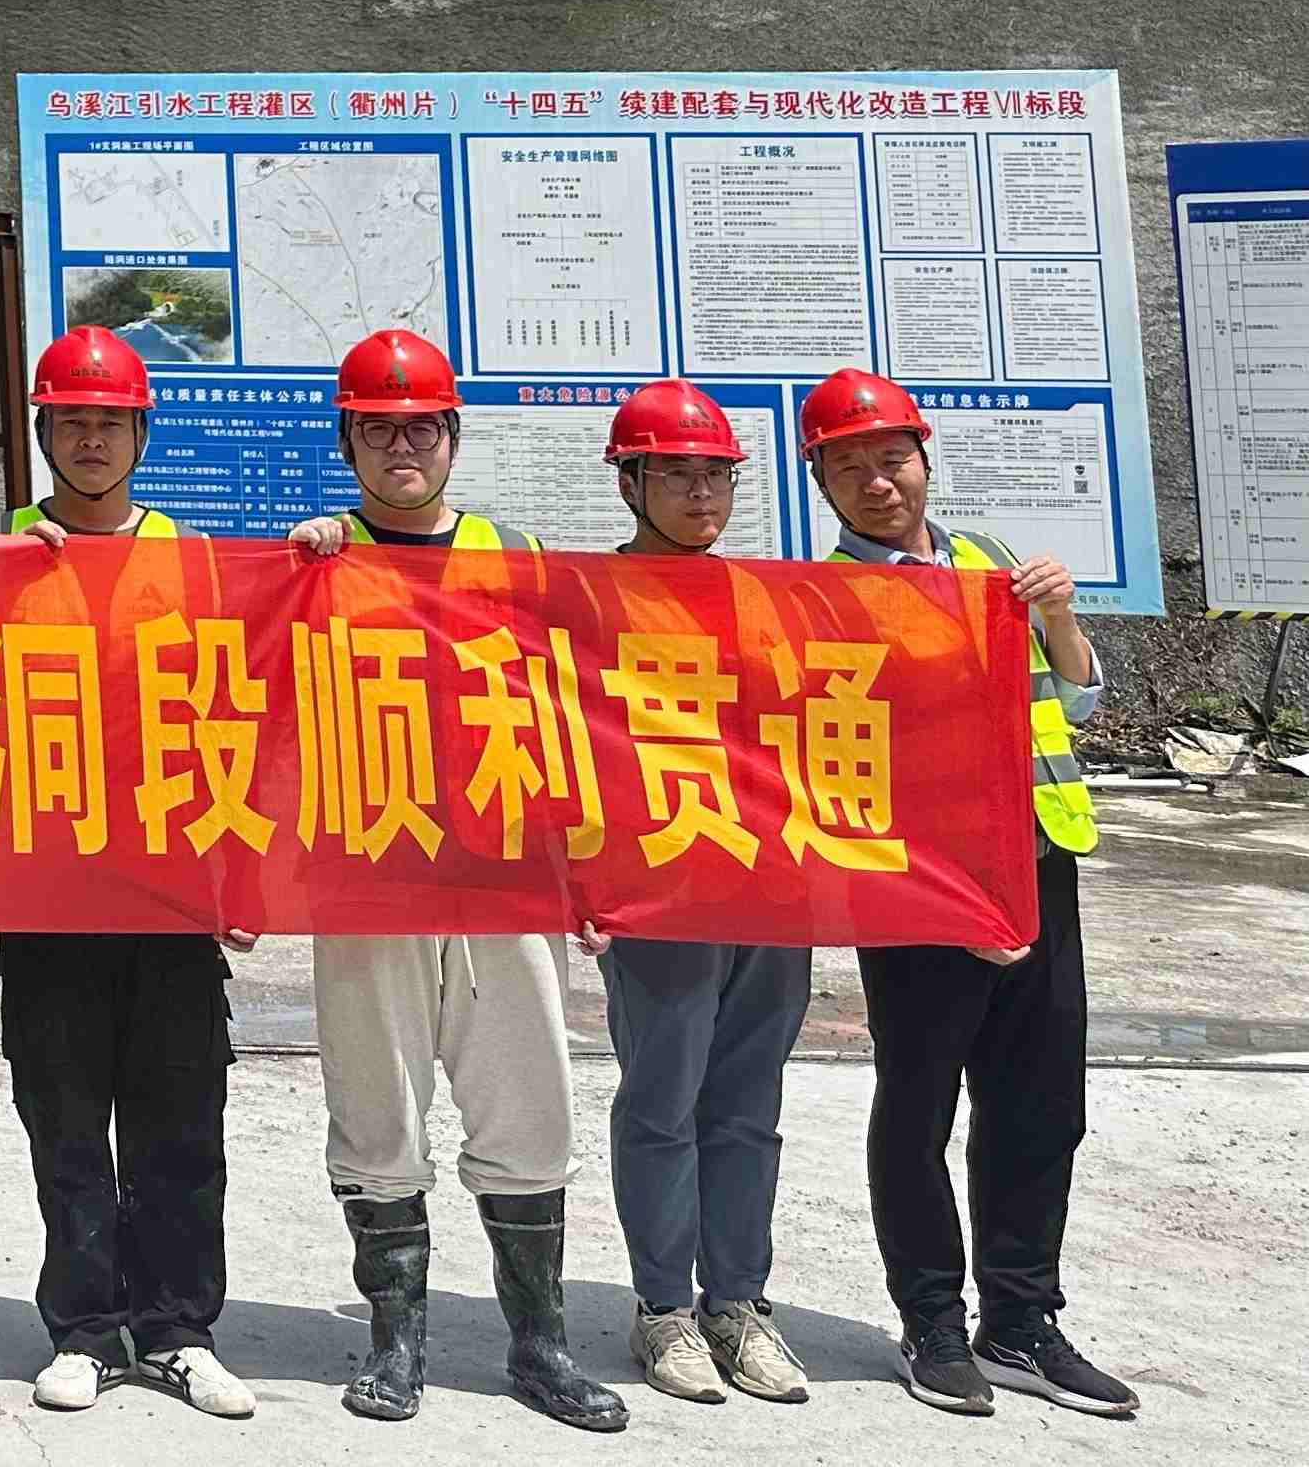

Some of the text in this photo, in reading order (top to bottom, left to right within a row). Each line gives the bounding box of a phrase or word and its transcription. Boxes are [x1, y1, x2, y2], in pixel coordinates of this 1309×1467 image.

[501, 150, 618, 163] 安全生产管理网络图
[739, 145, 796, 158] 工程概况
[518, 387, 639, 402] 重大危险源公
[911, 393, 1031, 408] 权信息告示牌
